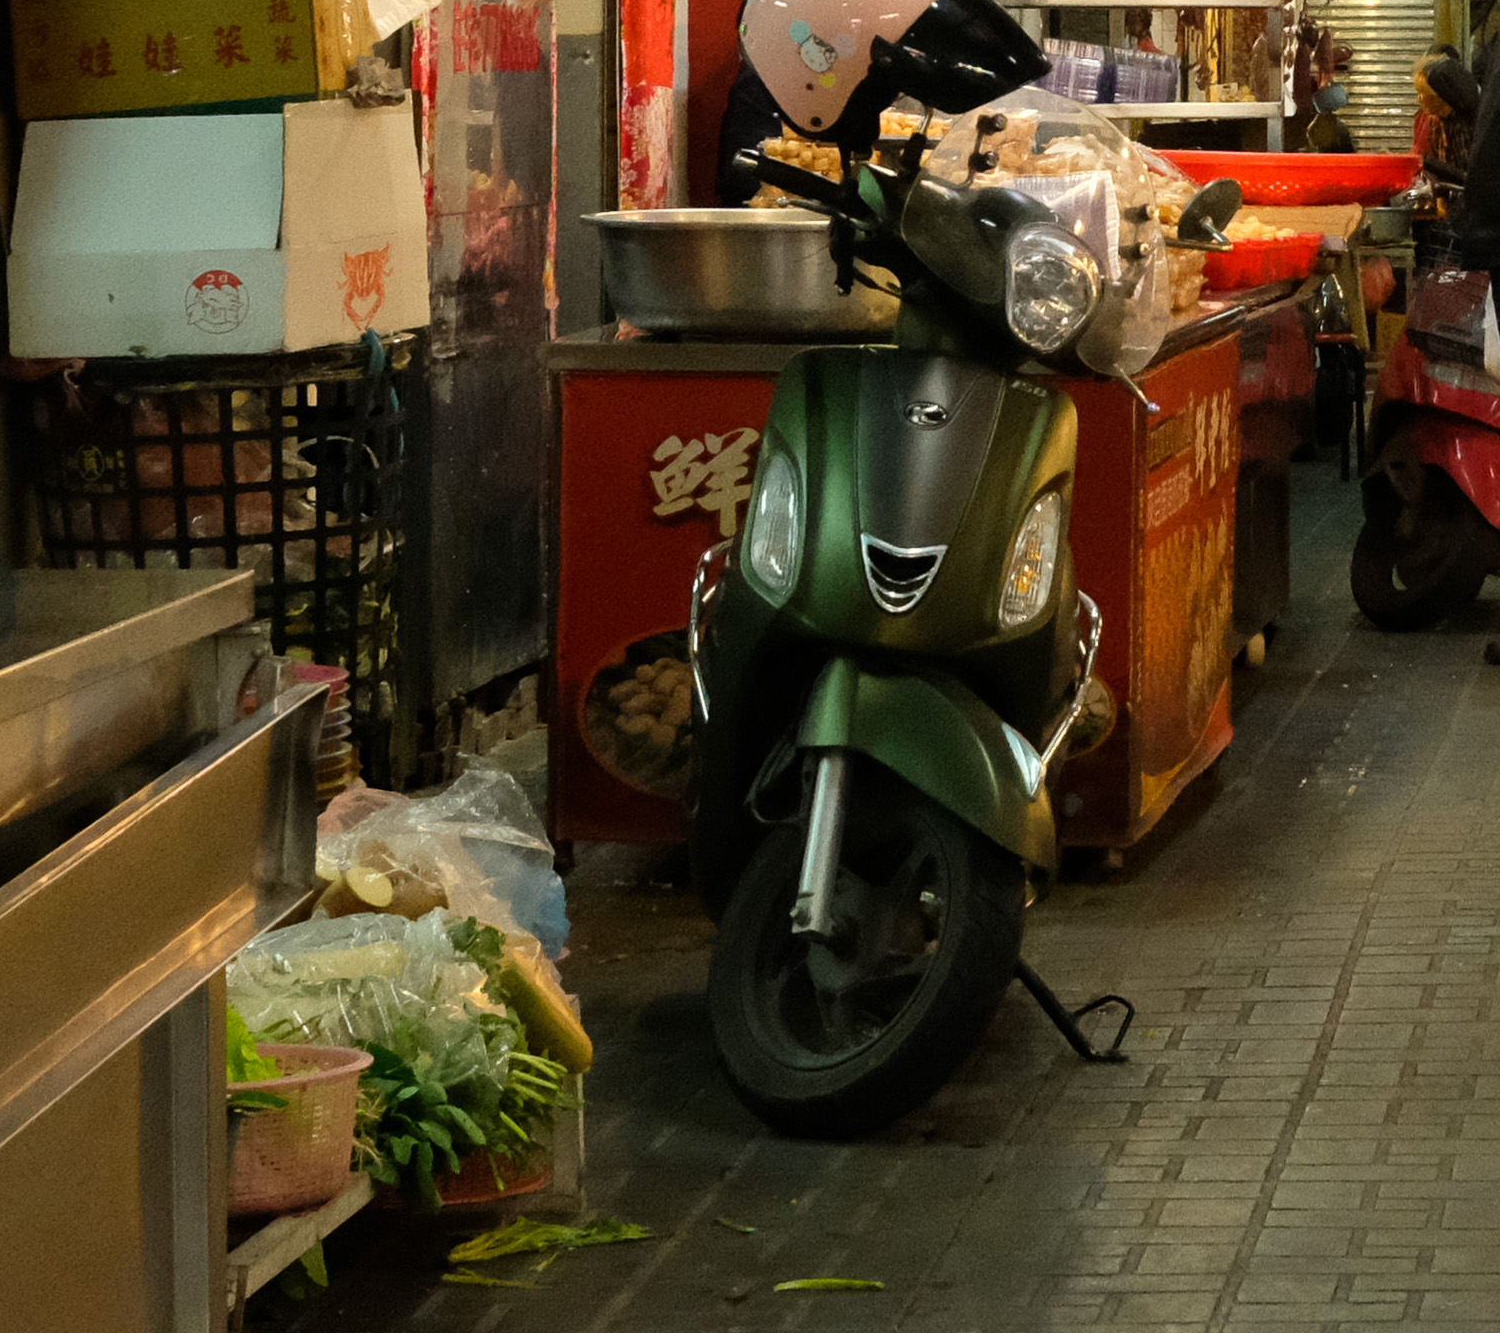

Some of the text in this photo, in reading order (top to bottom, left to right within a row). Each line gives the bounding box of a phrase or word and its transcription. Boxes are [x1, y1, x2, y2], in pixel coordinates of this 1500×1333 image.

[76, 23, 252, 80] 娃娃菜
[648, 426, 762, 535] 鮮
